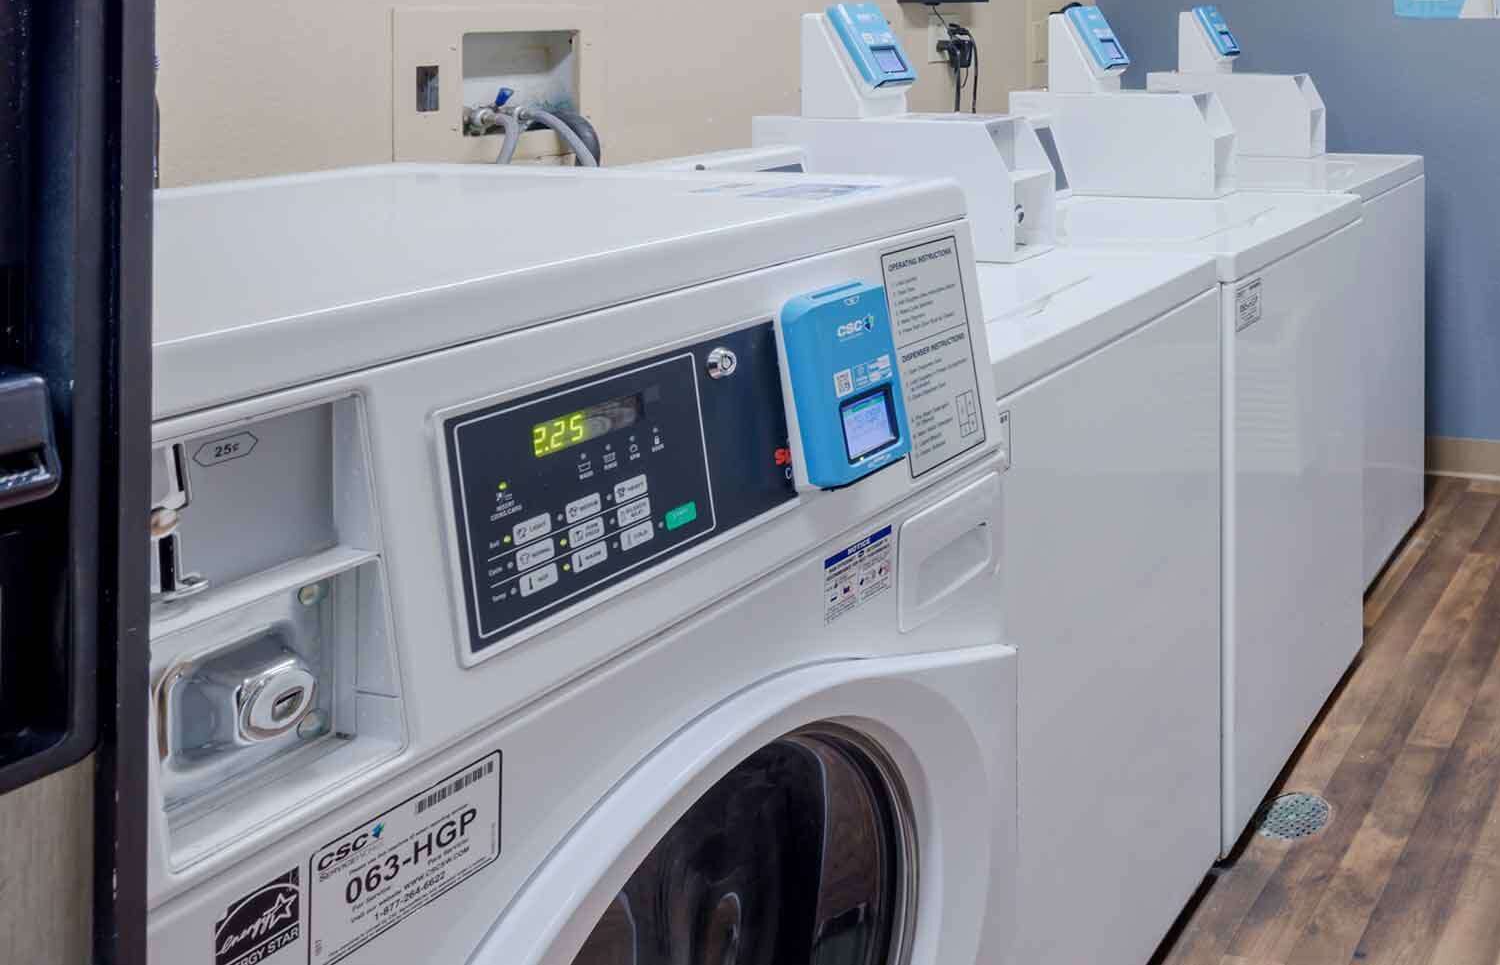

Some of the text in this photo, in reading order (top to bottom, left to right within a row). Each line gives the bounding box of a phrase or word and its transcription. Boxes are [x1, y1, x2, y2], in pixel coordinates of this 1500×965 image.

[888, 247, 953, 272] OPERATING INSTRUCTIONS
[837, 321, 863, 337] CSC
[931, 332, 965, 351] INSTRUCTIONS
[533, 414, 585, 457] 2.25
[213, 442, 240, 458] 25¢
[847, 537, 871, 555] NOTICE
[317, 832, 369, 872] CSC
[345, 808, 477, 904] 063-HGP
[374, 871, 446, 921] 1-877-264-6622
[267, 927, 298, 953] STAR
